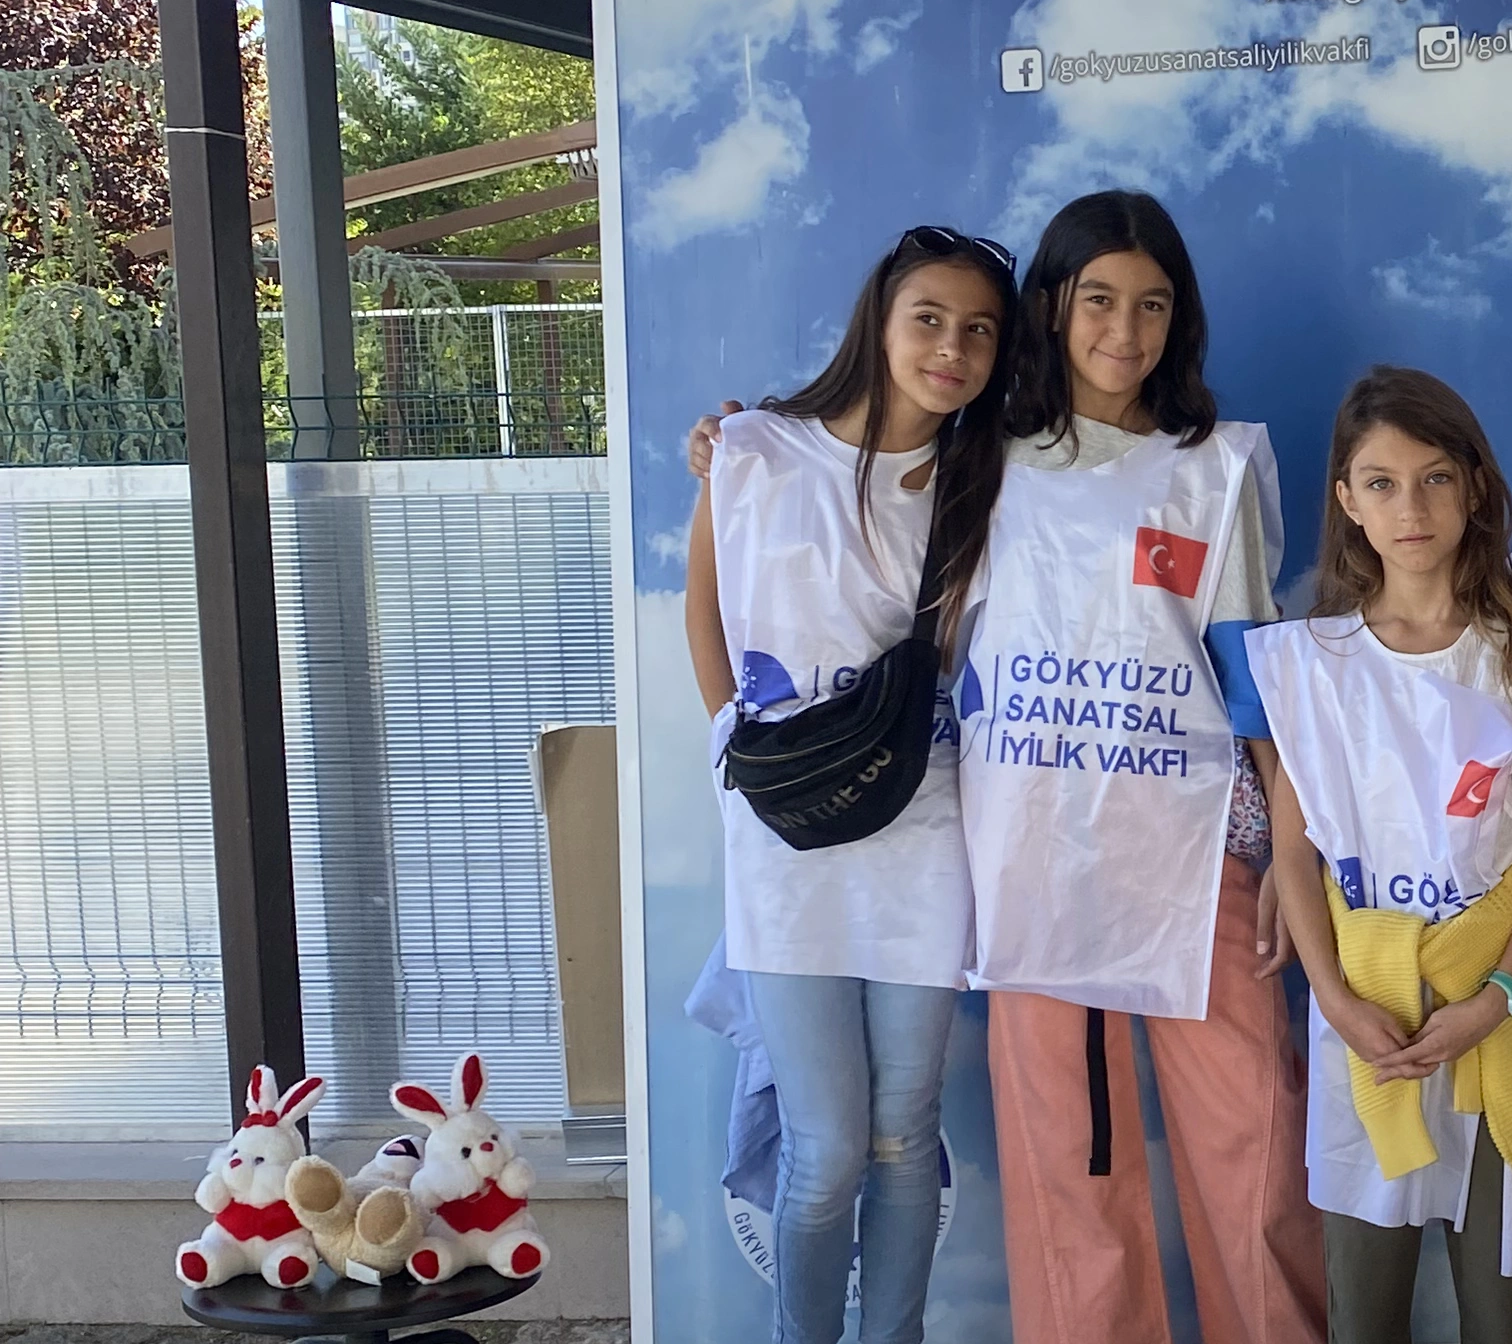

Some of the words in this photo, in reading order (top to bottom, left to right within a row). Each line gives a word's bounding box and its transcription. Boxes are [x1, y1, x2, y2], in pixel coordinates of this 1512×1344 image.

[1049, 37, 1371, 84] /gokyuzusanatsaliyilikvakfi
[1010, 650, 1193, 698] GÖKYÜZÜ
[1005, 693, 1188, 736] SANATSAL
[999, 729, 1088, 771] İYİLİK
[1095, 742, 1188, 778] VAKFI
